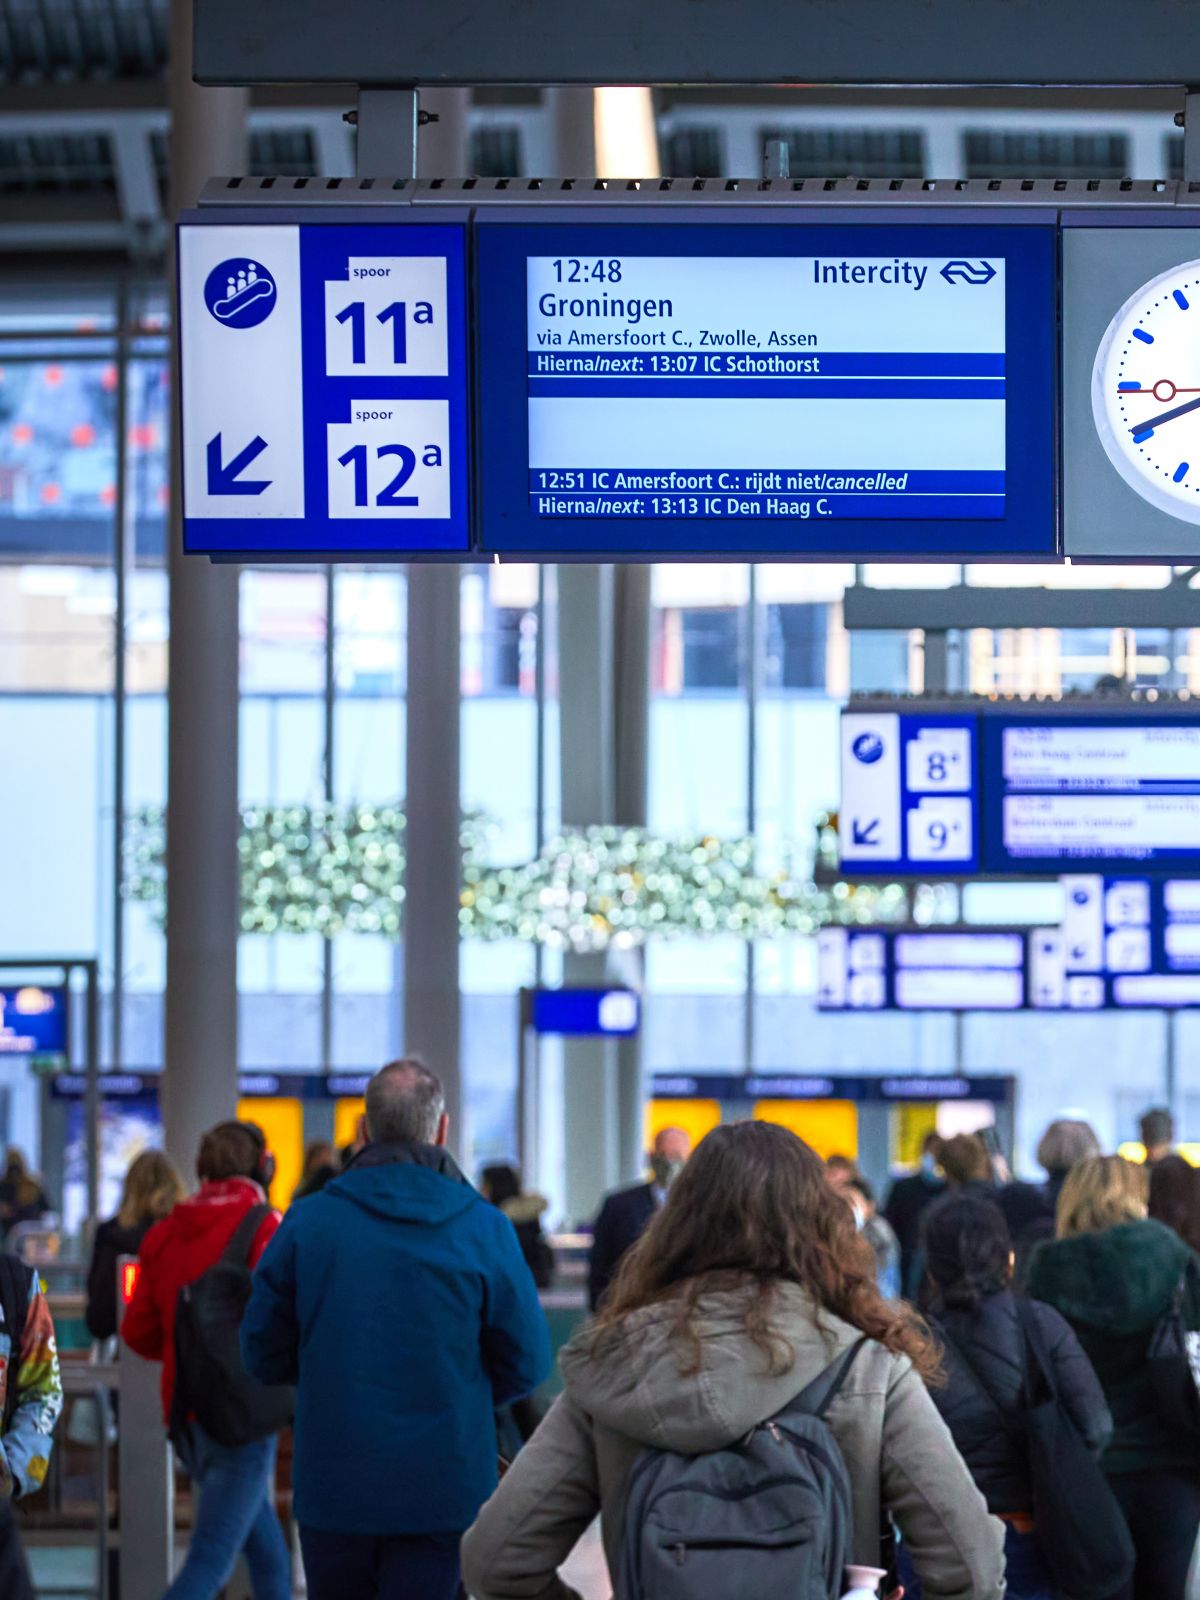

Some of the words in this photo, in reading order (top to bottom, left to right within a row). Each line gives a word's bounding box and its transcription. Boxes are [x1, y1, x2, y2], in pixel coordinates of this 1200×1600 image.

[354, 269, 390, 279] spoor
[553, 259, 621, 282] 12:48
[815, 259, 927, 290] Intercity
[539, 293, 672, 323] Groningen
[335, 302, 433, 364] 11a
[537, 329, 561, 345] via
[568, 329, 665, 345] Amersfoort
[672, 330, 692, 347] C.,
[700, 330, 760, 348] Zwolle,
[768, 331, 817, 345] Assen
[538, 355, 643, 371] Hierna/next:
[651, 356, 697, 371] 13:07
[705, 356, 721, 372] IC
[727, 355, 819, 372] Schothorst
[356, 412, 392, 421] spoor
[338, 444, 441, 506] 12a
[540, 473, 583, 488] 12:51
[593, 473, 609, 488] IC
[614, 472, 712, 489] Amersfoort
[718, 473, 739, 489] C.:
[744, 473, 783, 494] rijdt
[787, 473, 908, 489] niet/cancelled
[539, 497, 644, 513] Hierna/next:
[652, 498, 697, 513] 13:13
[705, 498, 721, 514] IC
[728, 499, 760, 514] Den
[767, 499, 810, 518] Haag
[817, 499, 832, 514] C.
[927, 821, 961, 851] 9
